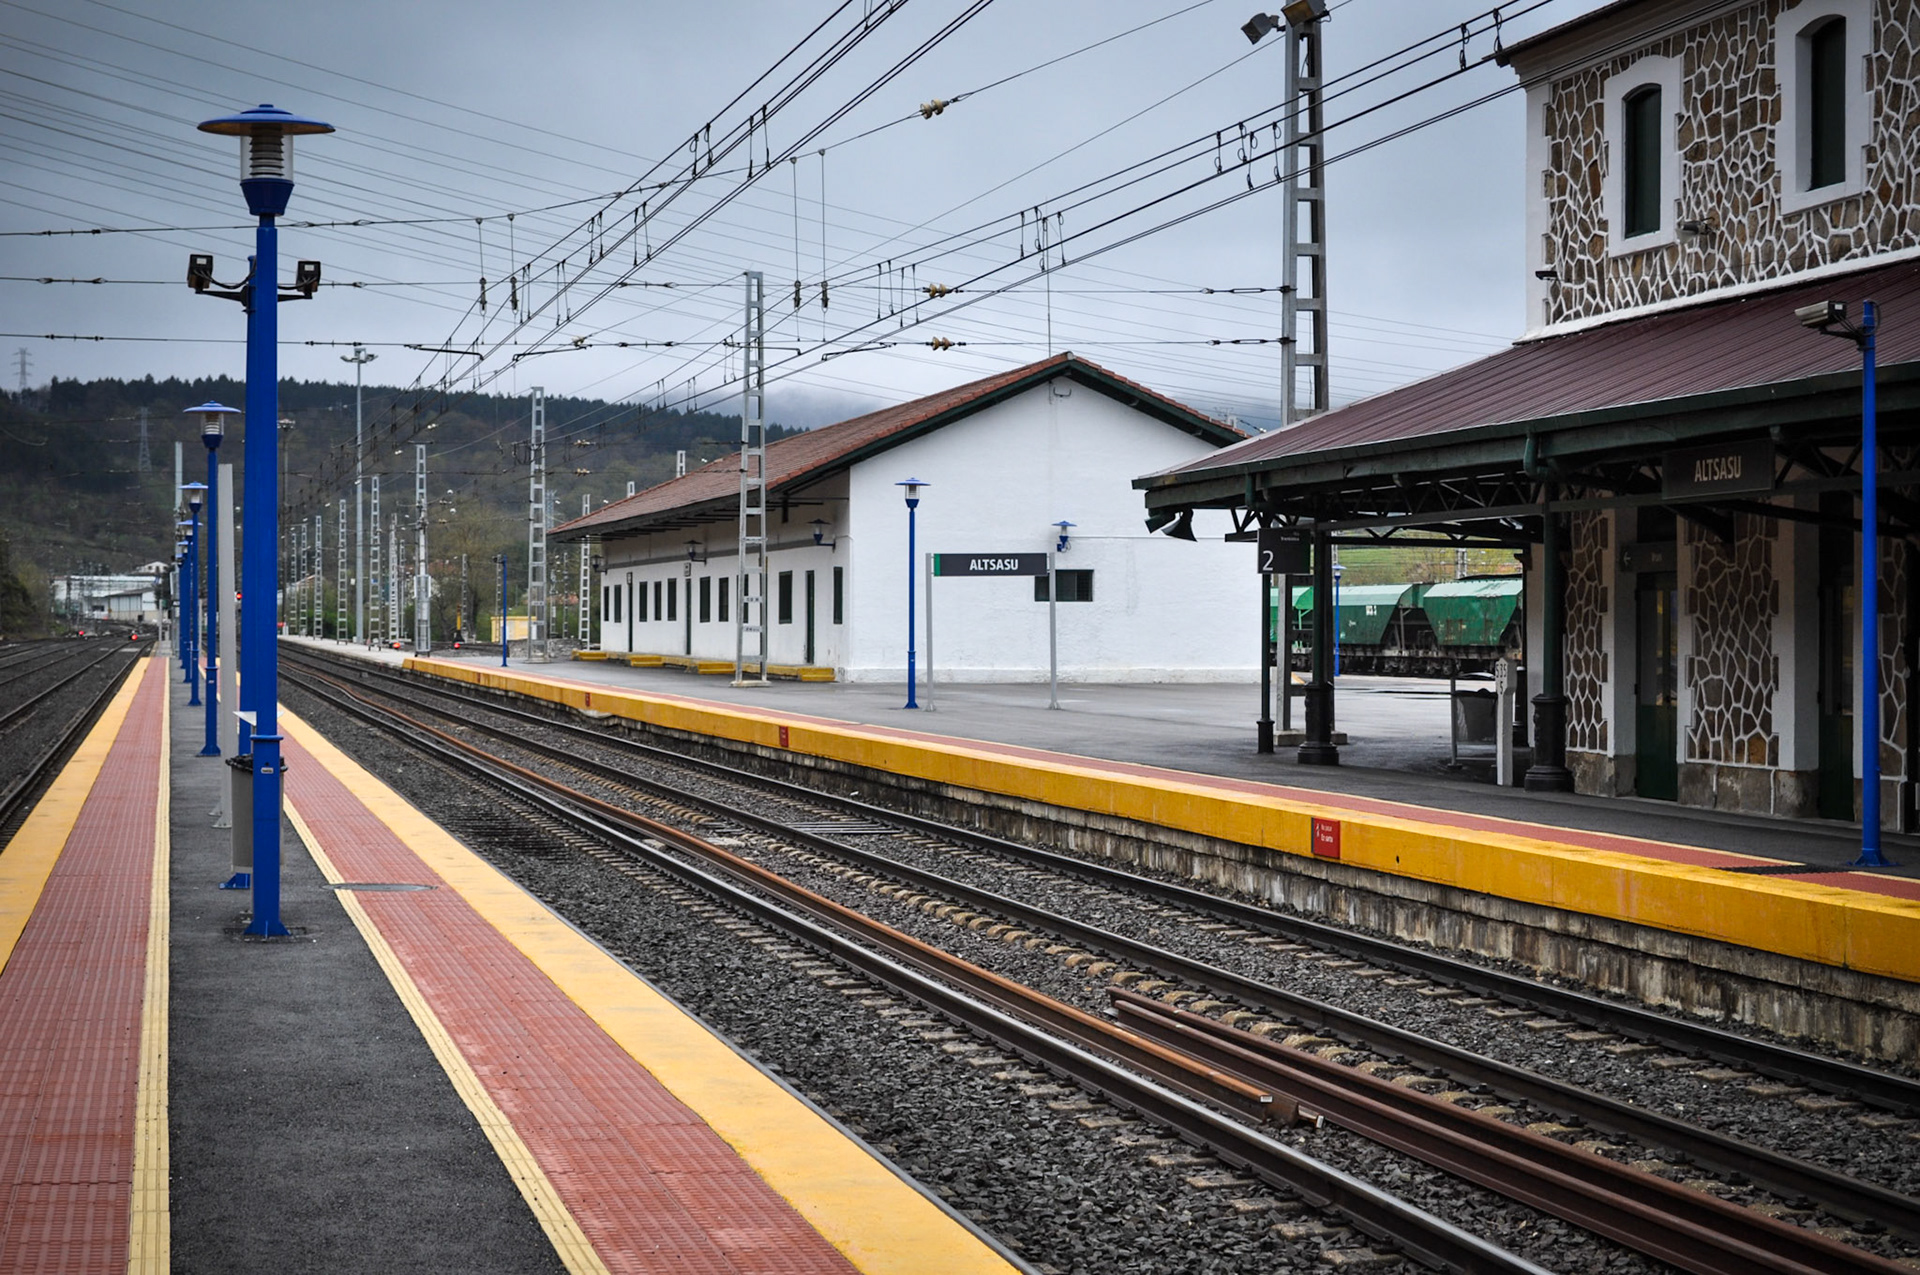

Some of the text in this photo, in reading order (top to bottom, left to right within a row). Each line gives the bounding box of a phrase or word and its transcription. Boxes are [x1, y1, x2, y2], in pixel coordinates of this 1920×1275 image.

[1694, 455, 1742, 482] ALTSASU
[969, 558, 1019, 571] ALTSASU
[1262, 550, 1274, 571] 2
